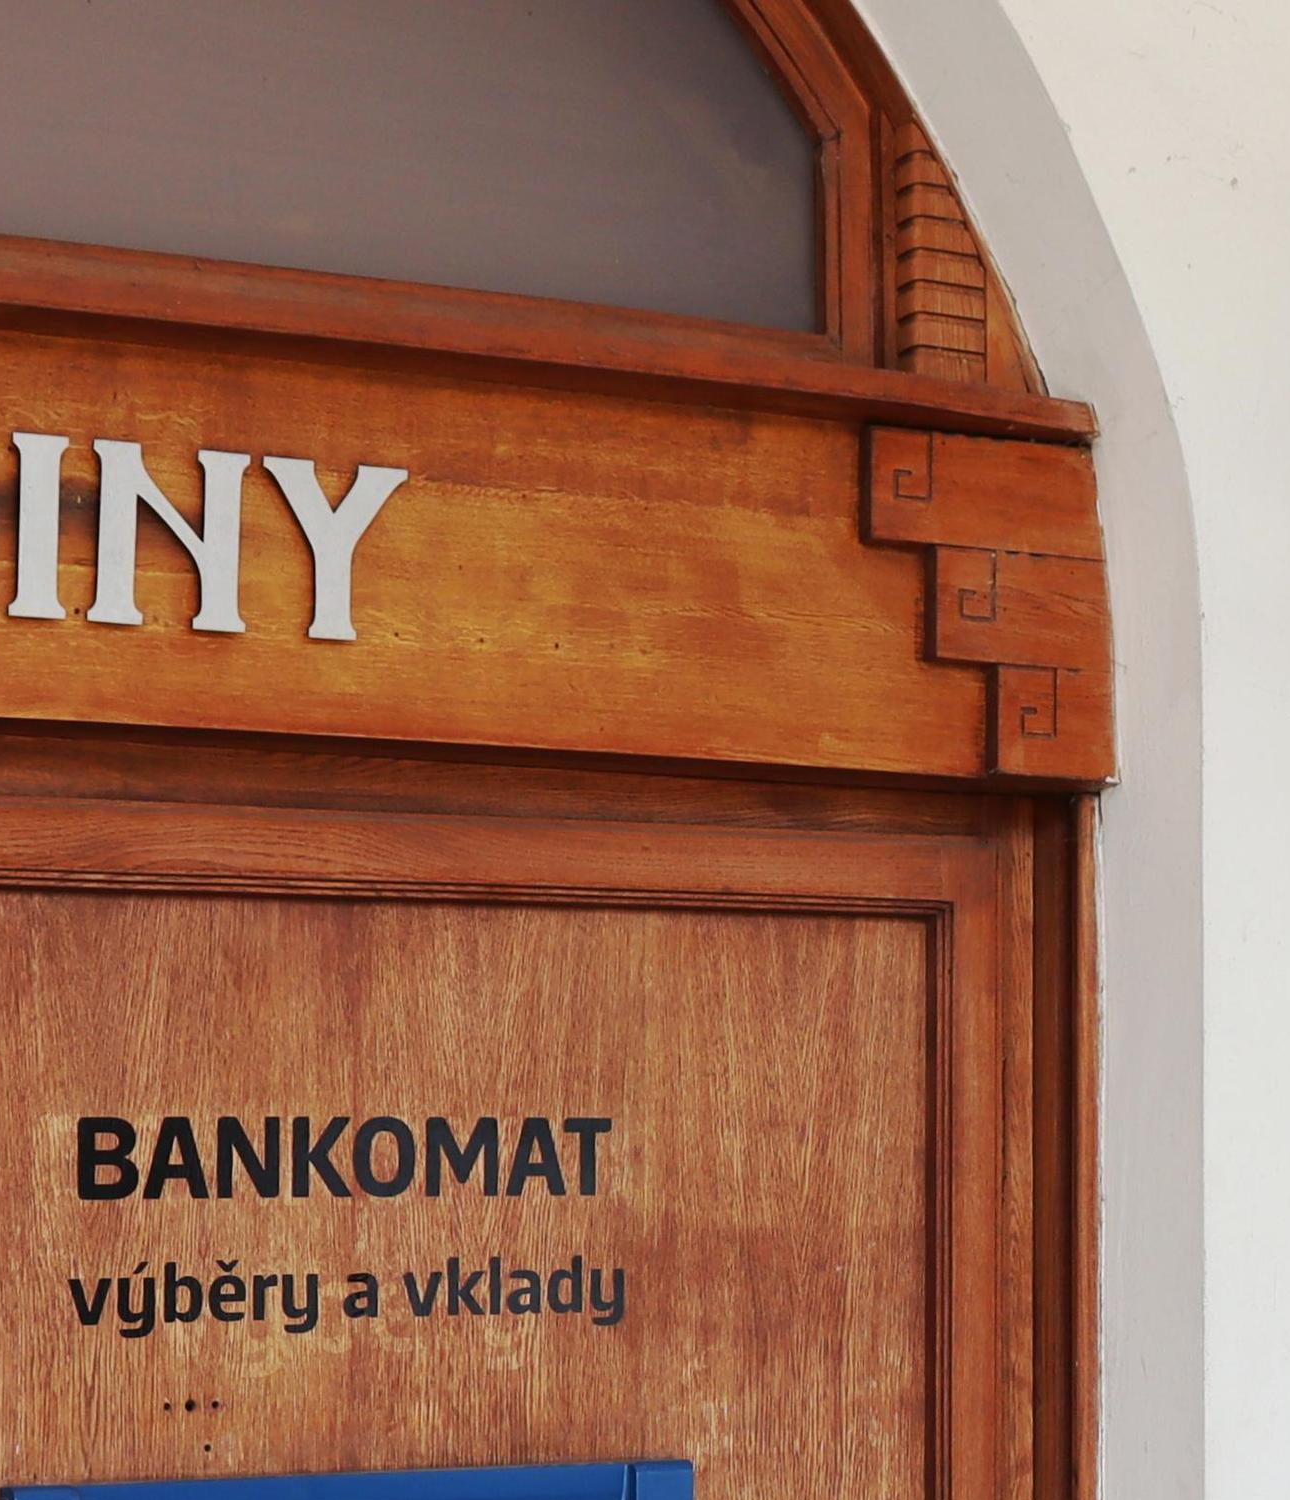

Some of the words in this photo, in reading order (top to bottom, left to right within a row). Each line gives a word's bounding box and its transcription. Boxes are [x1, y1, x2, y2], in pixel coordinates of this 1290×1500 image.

[76, 1116, 613, 1200] BANKOMAT
[67, 1259, 320, 1338] výběry
[343, 1271, 379, 1319] a
[402, 1255, 626, 1327] vklady
